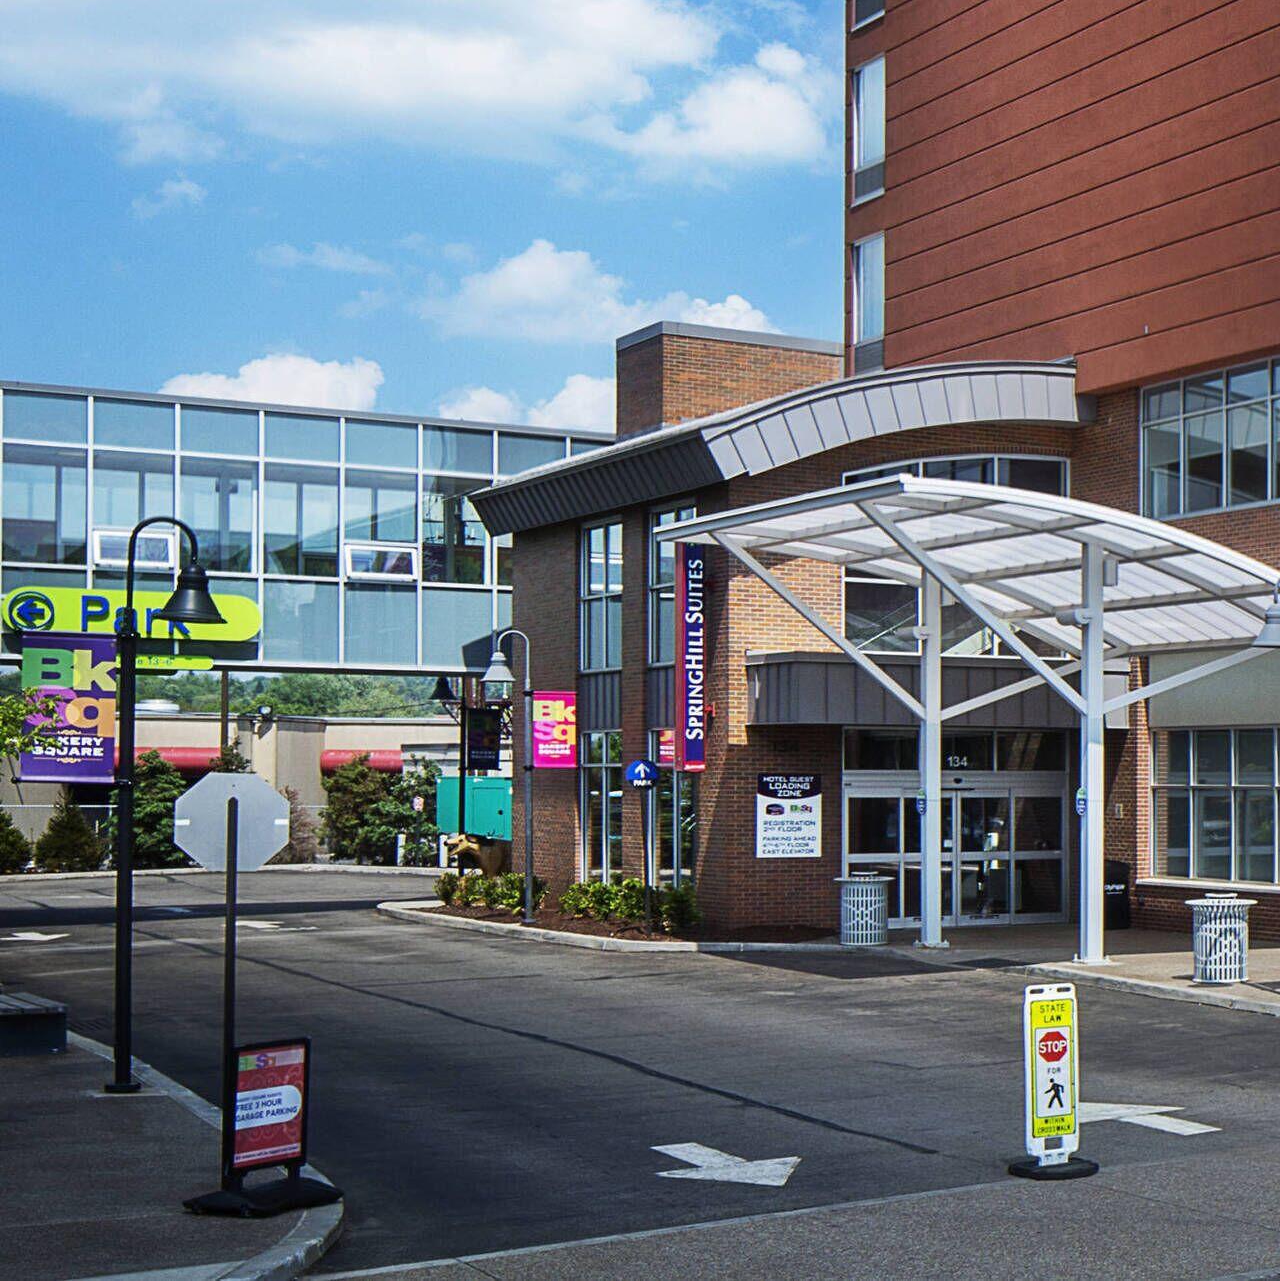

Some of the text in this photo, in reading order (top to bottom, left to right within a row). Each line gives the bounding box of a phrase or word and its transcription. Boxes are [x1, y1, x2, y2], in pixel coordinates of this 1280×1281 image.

[686, 559, 705, 740] SPRINGHILL SUITES
[22, 648, 116, 691] Bk
[533, 700, 576, 722] Bk
[533, 721, 576, 745] Sq
[32, 746, 104, 757] SQUARE
[947, 756, 968, 767] 134
[1039, 1003, 1065, 1013] STATE
[1043, 1015, 1062, 1023] LAW
[1039, 1040, 1067, 1054] STOP
[1047, 1066, 1061, 1074] FOR
[261, 1097, 282, 1107] HOUR
[265, 1105, 298, 1118] PARKING
